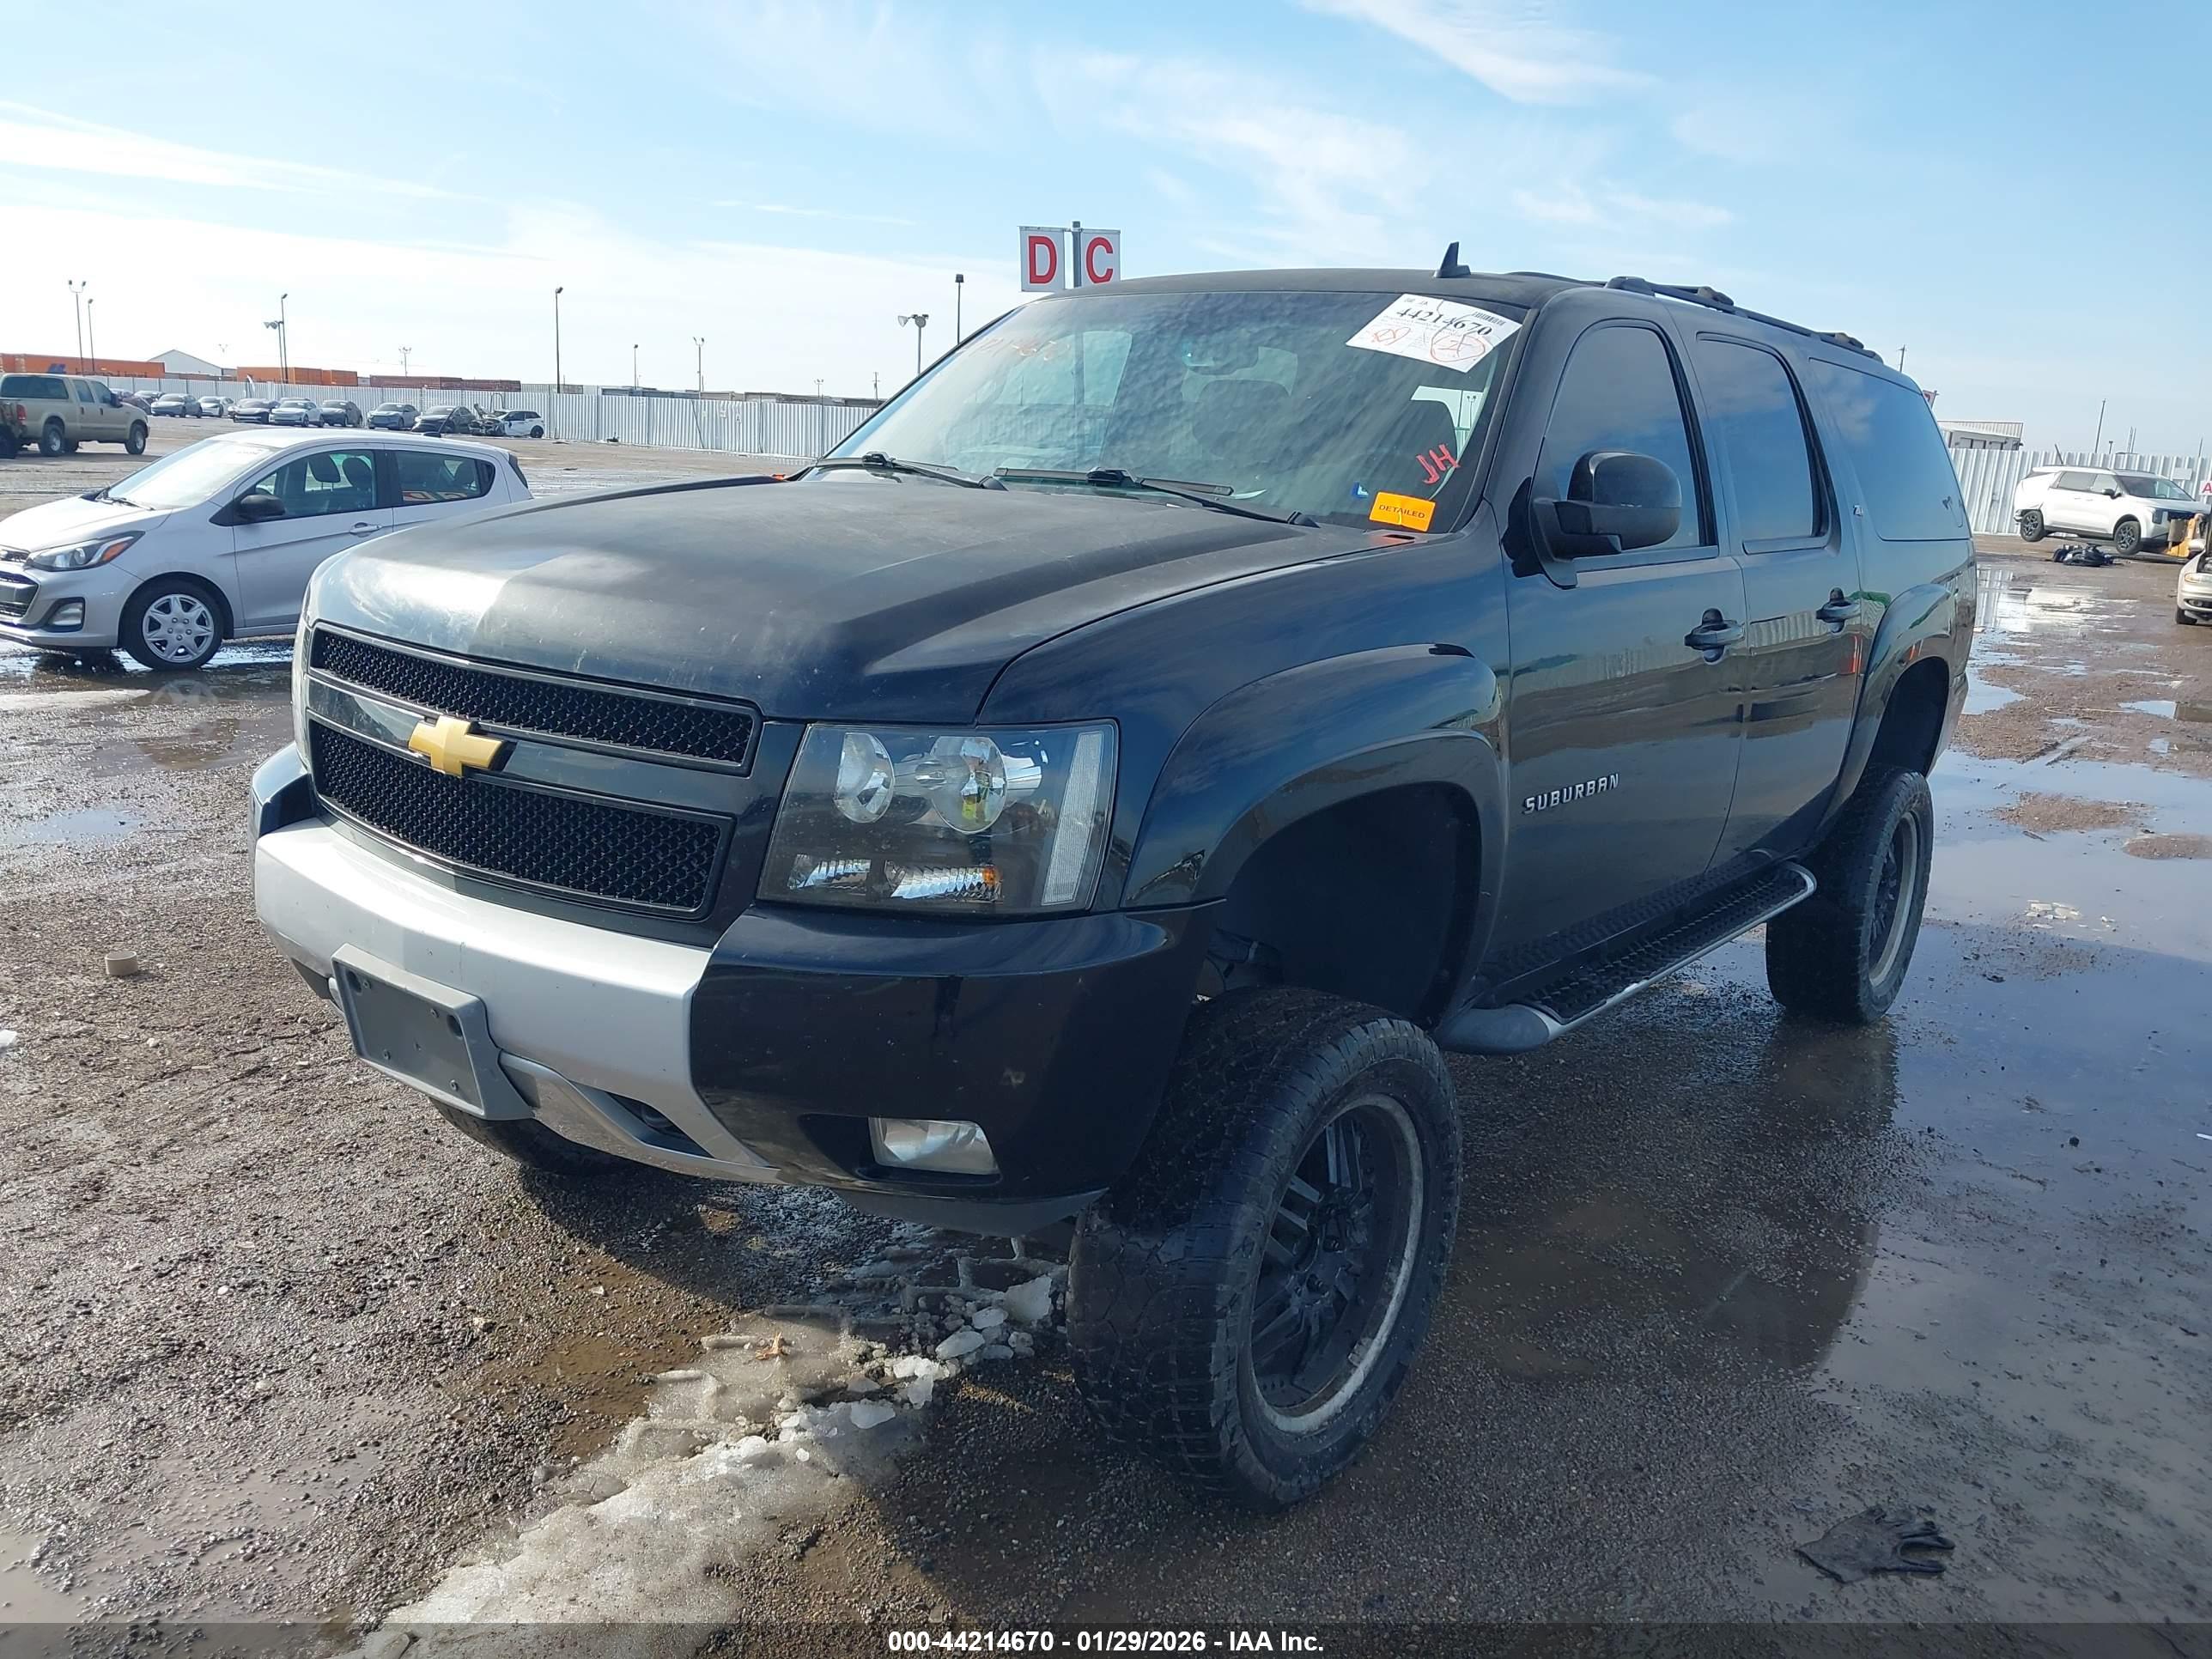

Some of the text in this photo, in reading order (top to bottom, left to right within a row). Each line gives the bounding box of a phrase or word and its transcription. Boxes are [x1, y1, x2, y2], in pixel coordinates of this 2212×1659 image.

[1028, 235, 1114, 284] D C
[1396, 307, 1493, 336] 44214670
[1416, 443, 1461, 484] JH
[1378, 503, 1426, 519] DETAILED
[1522, 773, 1620, 815] SUBURBAN
